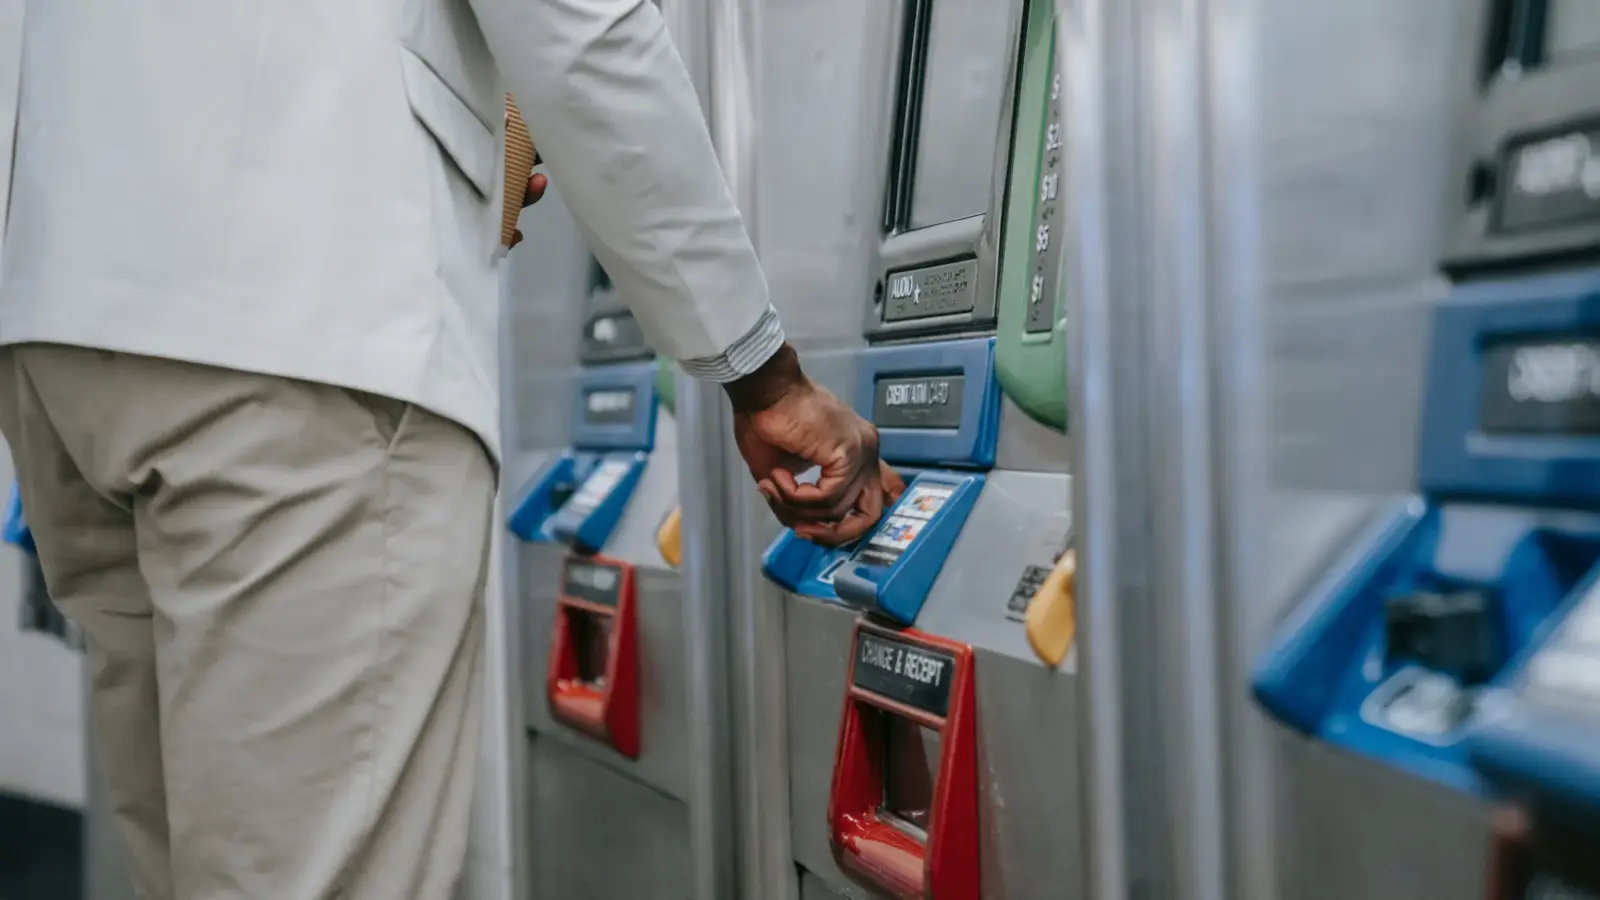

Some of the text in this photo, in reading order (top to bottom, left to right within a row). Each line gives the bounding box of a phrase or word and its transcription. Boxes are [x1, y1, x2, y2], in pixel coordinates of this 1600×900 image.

[1046, 123, 1064, 151] $2
[1040, 173, 1058, 202] $10
[1036, 224, 1050, 251] $5
[891, 275, 913, 299] AUDIO
[1031, 275, 1044, 303] $1
[861, 640, 945, 687] CHANGE & RECEIPT
